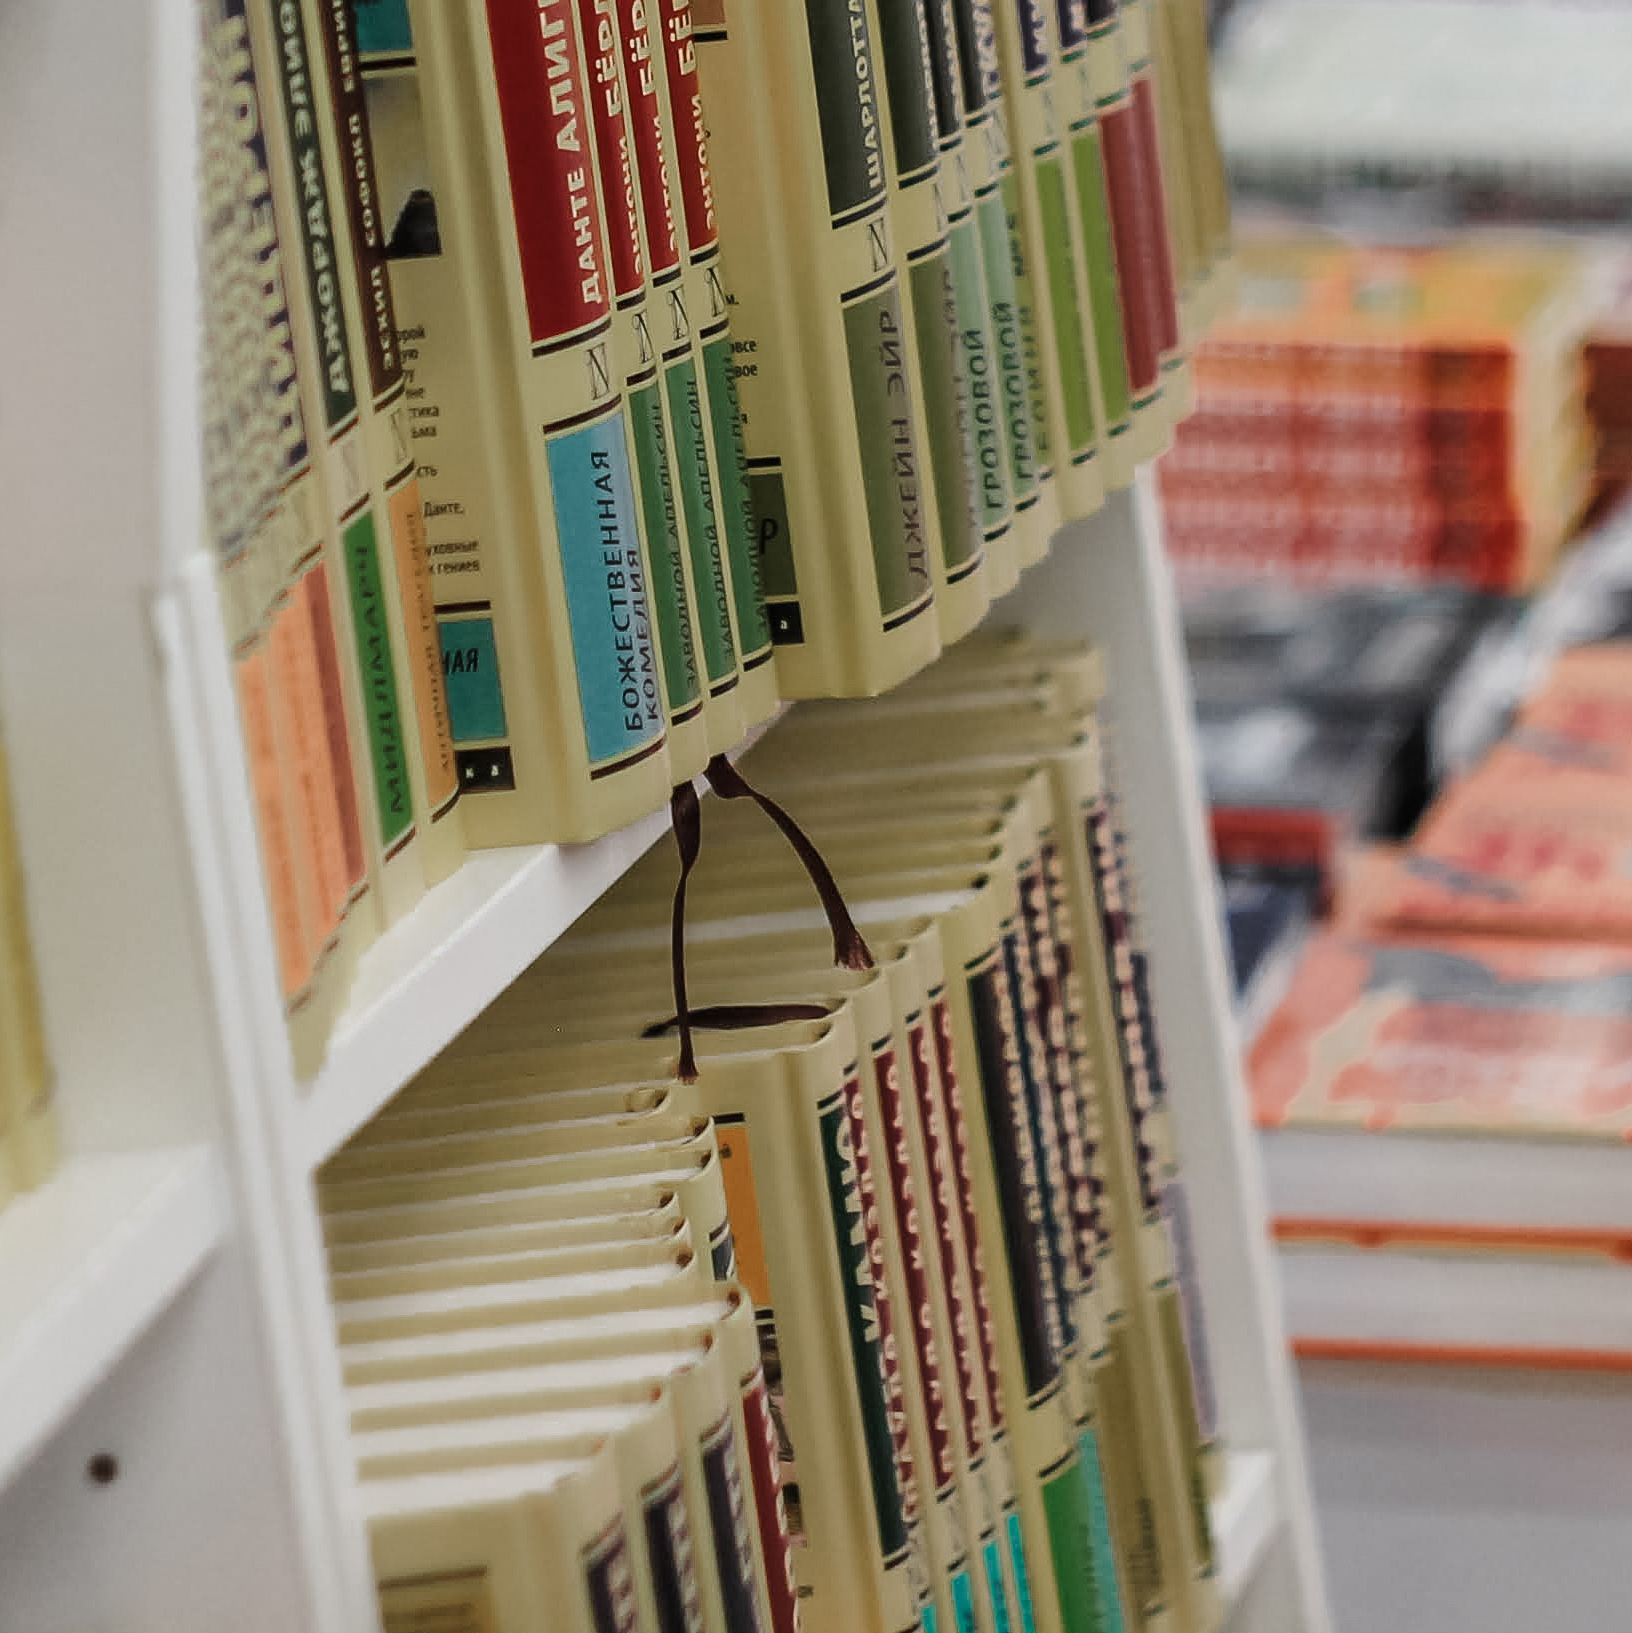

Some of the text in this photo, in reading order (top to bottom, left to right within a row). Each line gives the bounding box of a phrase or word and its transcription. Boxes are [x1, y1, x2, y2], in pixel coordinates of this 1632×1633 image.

[566, 168, 603, 305] ДАНТЕ
[689, 94, 716, 231] ЭНТОНИ
[298, 150, 350, 393] ДЖОРДЖ
[878, 310, 927, 578] ДЖЕЙН ЭЙР
[961, 330, 1003, 509] ГРОЗОВОЙ
[590, 450, 643, 732] БОЖЕСТВЕННАЯ
[626, 549, 659, 722] КОМЕДИЯ
